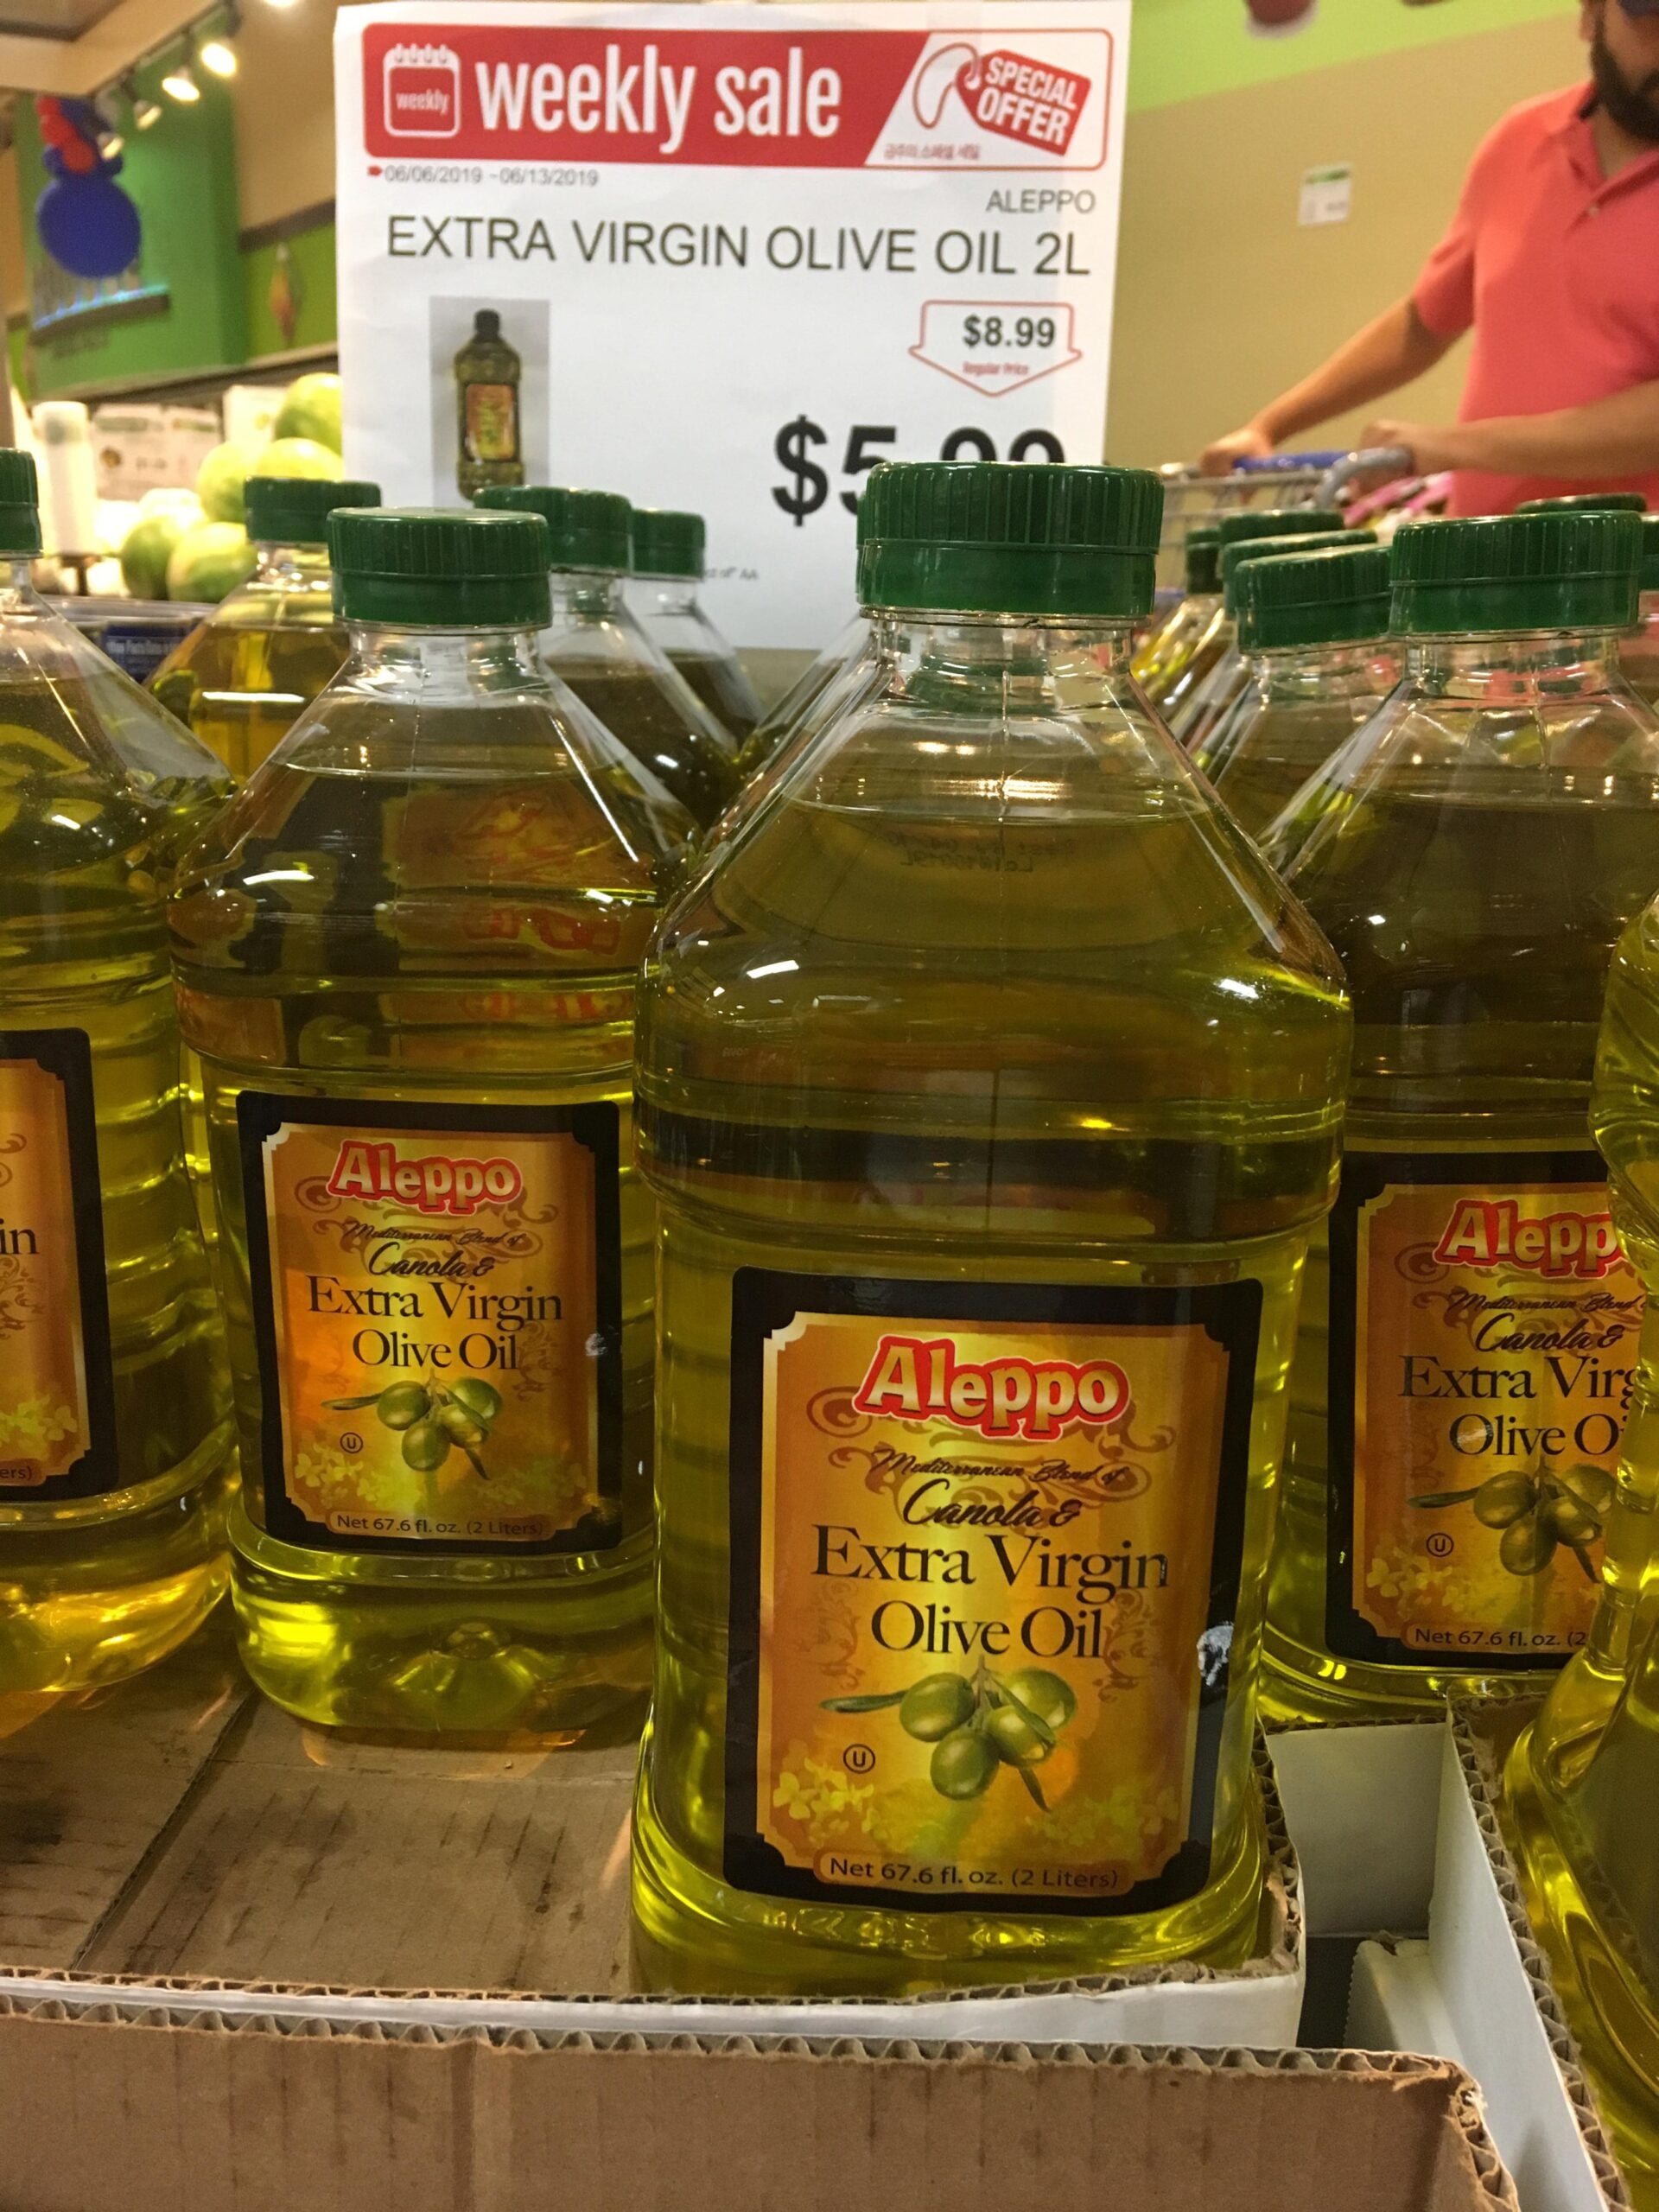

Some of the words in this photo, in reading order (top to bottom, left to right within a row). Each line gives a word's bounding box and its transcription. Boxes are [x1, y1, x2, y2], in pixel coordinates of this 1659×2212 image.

[396, 88, 450, 117] weekly
[475, 44, 696, 155] weekly
[714, 47, 842, 138] sale
[985, 56, 1077, 110] SPECIAL
[977, 87, 1071, 145] OFFER
[985, 189, 1096, 214] ALEPPO
[388, 214, 556, 261] EXTRA
[572, 219, 748, 268] VIRGIN
[766, 226, 916, 273] OLIVE
[936, 229, 1015, 275] OIL
[1034, 231, 1090, 276] 2L
[963, 314, 1056, 348] $8.99
[330, 1142, 518, 1212] Aleppo
[369, 1242, 467, 1276] Canola
[473, 1257, 496, 1277] &
[1438, 1202, 1619, 1275] Alepp
[306, 1274, 423, 1319] Extra
[428, 1282, 563, 1332] Virgin
[353, 1327, 451, 1369] Olive
[459, 1332, 518, 1370] Oil
[1475, 1313, 1592, 1352] Canola
[1597, 1325, 1625, 1349] &
[859, 1339, 1123, 1437] Aleppo
[1397, 1354, 1537, 1399] Extra
[1449, 1412, 1566, 1457] Olive
[869, 1448, 1026, 1477] Mediterranean
[1028, 1458, 1103, 1483] Blend
[902, 1478, 1042, 1527] Canola
[1048, 1498, 1083, 1528] &
[336, 1515, 369, 1530] Net
[372, 1517, 411, 1534] 67.6
[415, 1517, 432, 1534] fl.
[435, 1522, 461, 1535] oz.
[466, 1521, 486, 1536] (2
[488, 1521, 544, 1537] Liters)
[810, 1522, 977, 1586] Extra
[983, 1533, 1169, 1605] Virgin
[871, 1599, 1011, 1656] Olive
[1020, 1605, 1106, 1659] Oil
[1415, 1627, 1453, 1644] Net
[1458, 1630, 1503, 1646] 67.6
[1509, 1630, 1528, 1647] fl.
[1531, 1634, 1560, 1646] oz.
[830, 1857, 874, 1878] Net
[880, 1862, 934, 1885] 67.6
[941, 1865, 964, 1885] fl.
[969, 1871, 1003, 1886] oz.
[1011, 1868, 1035, 1889] (2
[1042, 1868, 1118, 1889] Liters)
